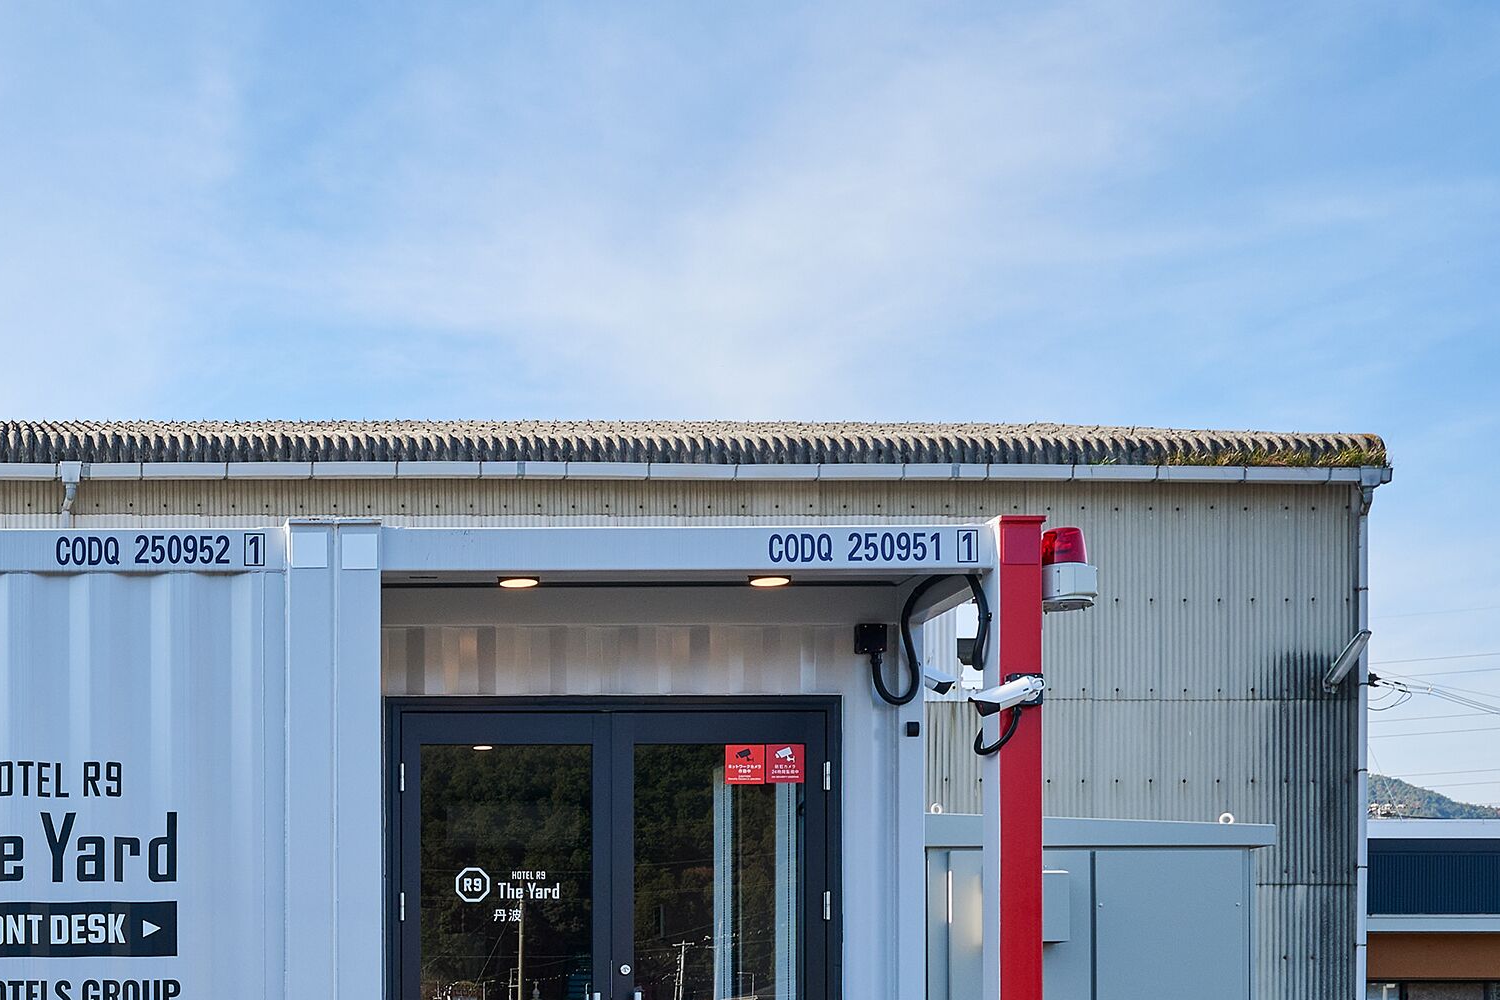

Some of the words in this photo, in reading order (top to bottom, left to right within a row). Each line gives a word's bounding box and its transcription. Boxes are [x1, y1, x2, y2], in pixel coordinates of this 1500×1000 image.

[56, 537, 120, 565] CODQ
[135, 535, 229, 564] 250952
[769, 534, 832, 562] CODQ
[848, 533, 940, 561] 250951
[84, 762, 121, 797] R9
[40, 812, 177, 882] Yard
[464, 878, 481, 891] R9
[512, 871, 534, 879] HOTEL
[536, 871, 545, 879] R9
[498, 883, 523, 899] The
[528, 883, 559, 899] Yard
[50, 914, 125, 944] DESK
[493, 908, 522, 922] 丹波
